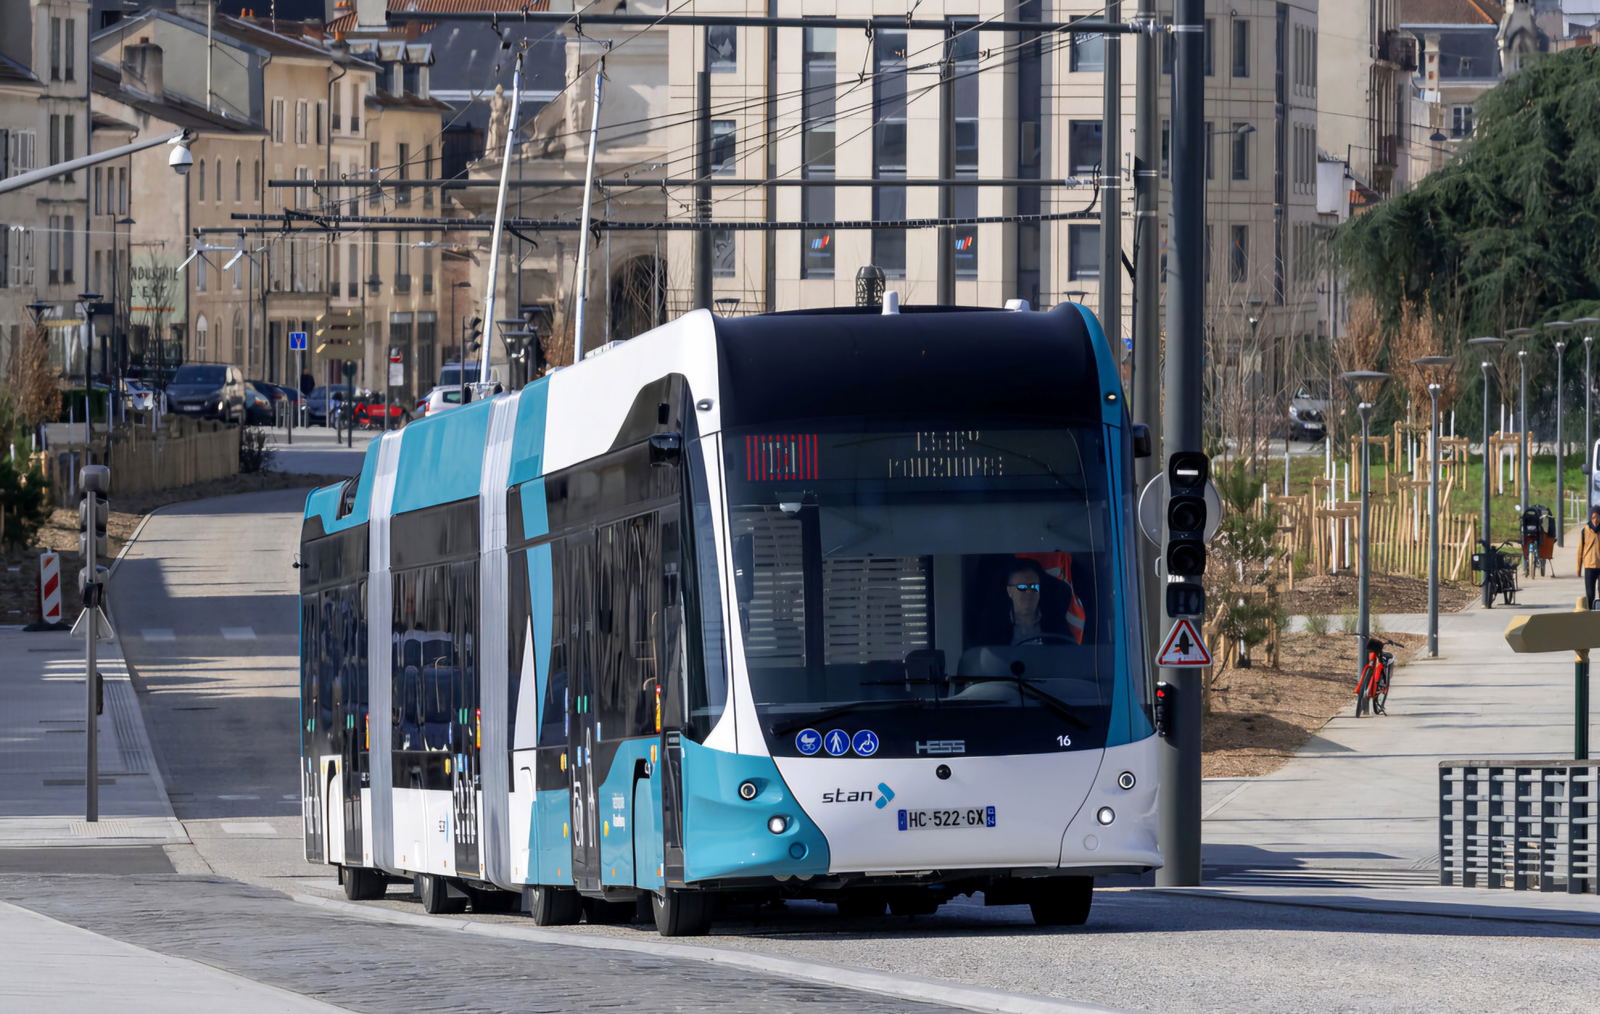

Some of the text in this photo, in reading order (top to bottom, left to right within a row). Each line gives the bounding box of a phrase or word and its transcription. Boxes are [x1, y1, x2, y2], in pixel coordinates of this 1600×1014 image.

[916, 740, 965, 753] HESS
[1057, 735, 1071, 746] 16
[822, 788, 872, 803] stan
